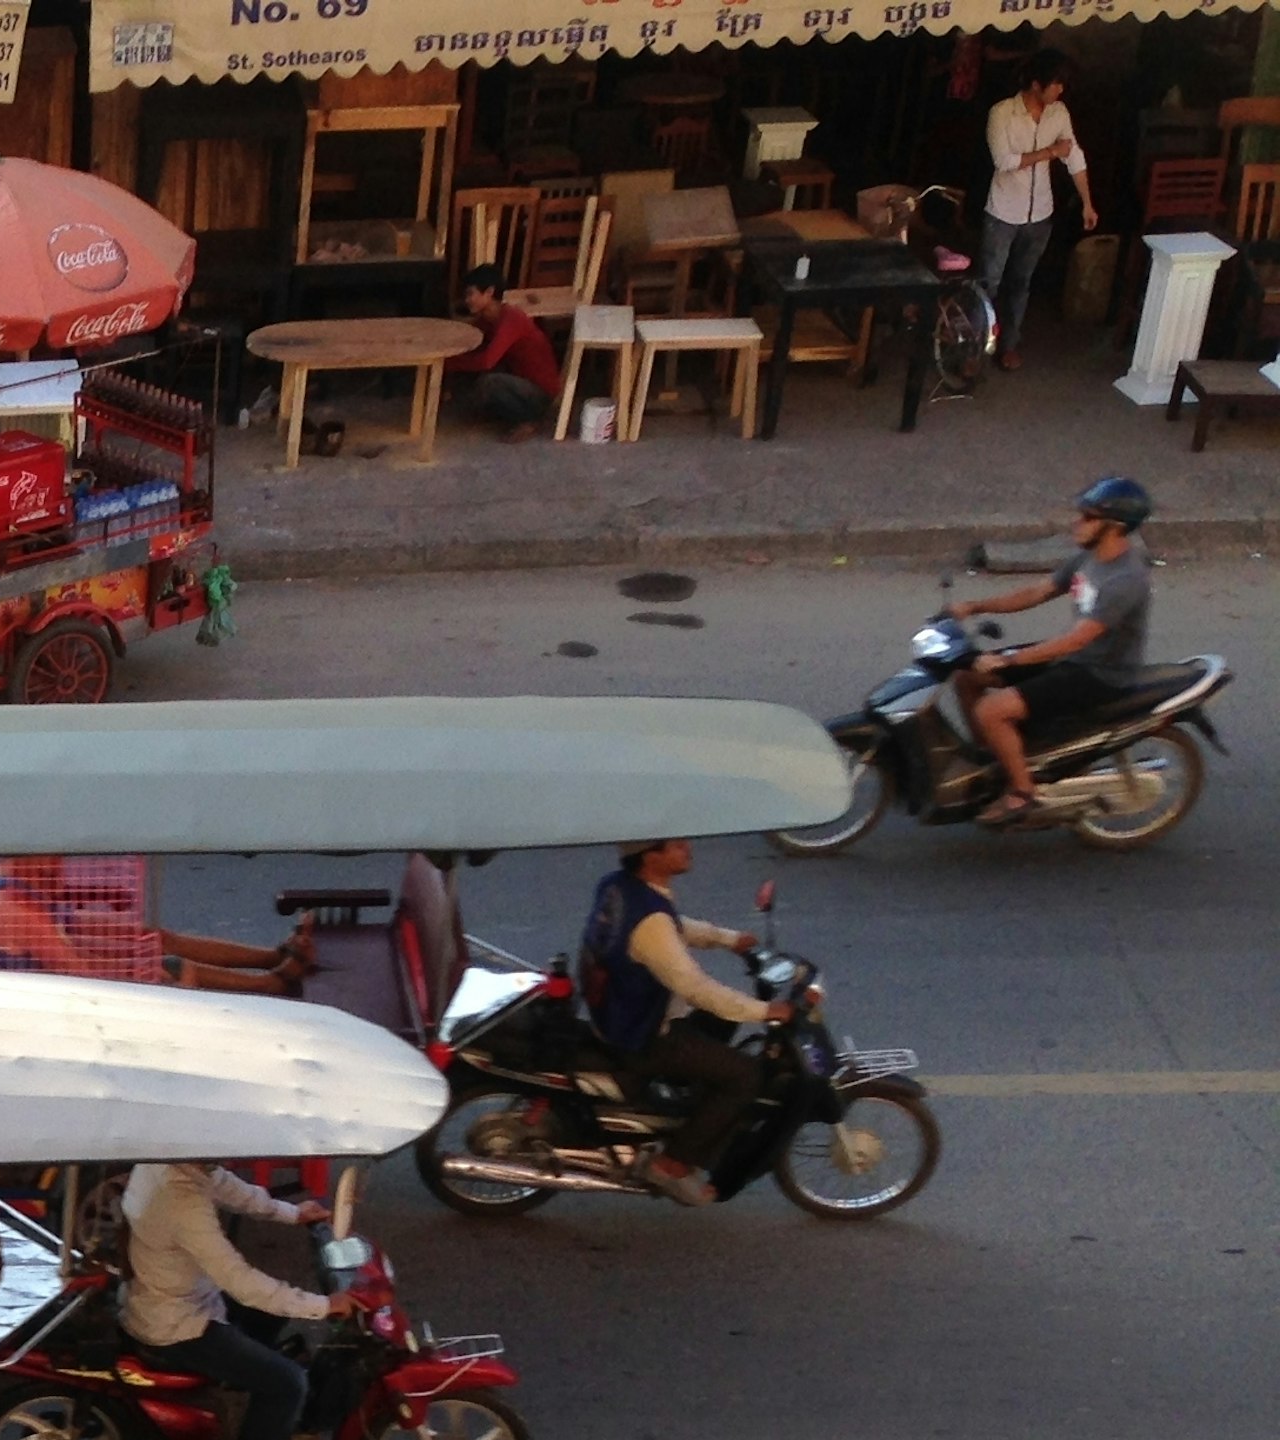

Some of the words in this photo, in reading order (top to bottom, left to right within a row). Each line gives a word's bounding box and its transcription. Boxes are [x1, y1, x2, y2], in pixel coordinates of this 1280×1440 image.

[231, 0, 300, 26] No.
[317, 0, 368, 20] 69
[228, 53, 254, 70] St.
[262, 48, 367, 67] Sothearos
[57, 239, 122, 273] Coca-Cola
[66, 301, 150, 344] Coca-Cola
